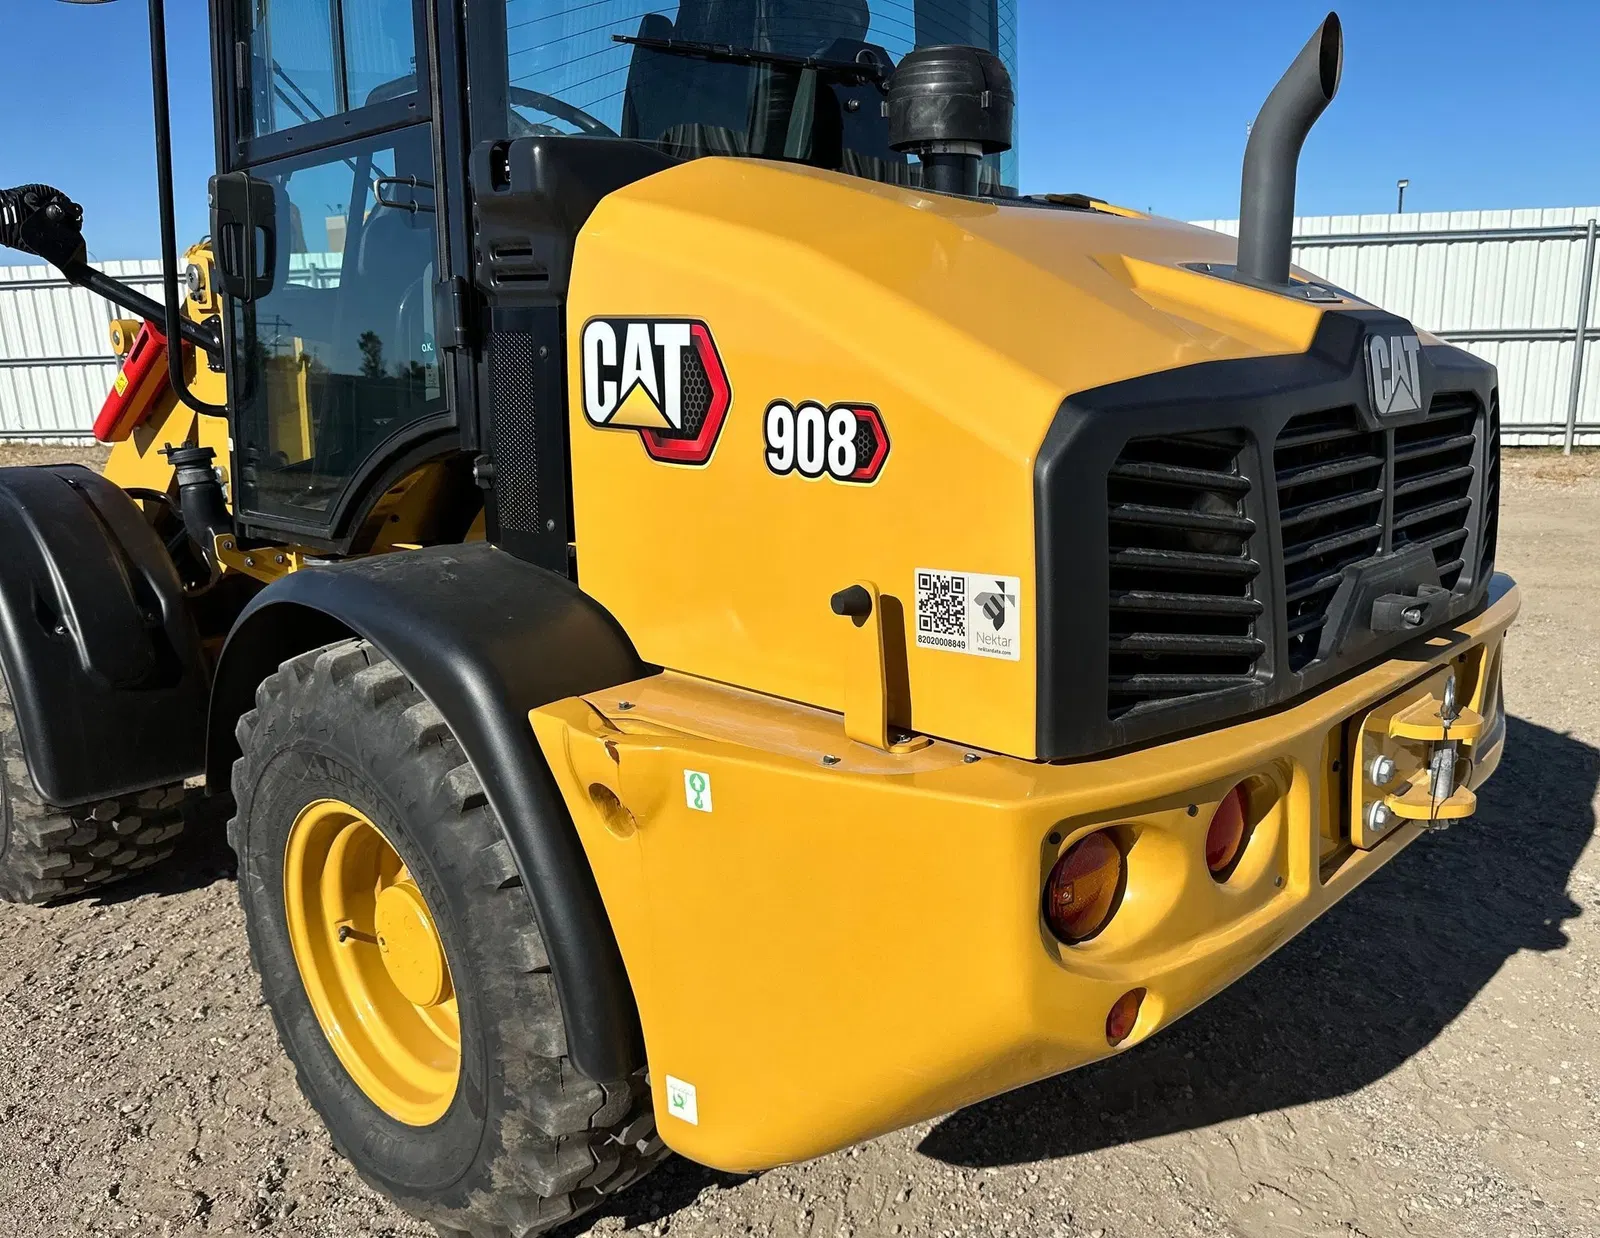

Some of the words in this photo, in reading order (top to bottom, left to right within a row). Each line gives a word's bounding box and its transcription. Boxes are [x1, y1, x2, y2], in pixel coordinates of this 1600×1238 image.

[584, 321, 691, 429] CAT
[1370, 335, 1421, 414] CAT
[767, 405, 857, 477] 908
[917, 634, 966, 649] 82020008849
[976, 631, 1012, 647] Nektar
[977, 646, 1012, 655] nektardata.com
